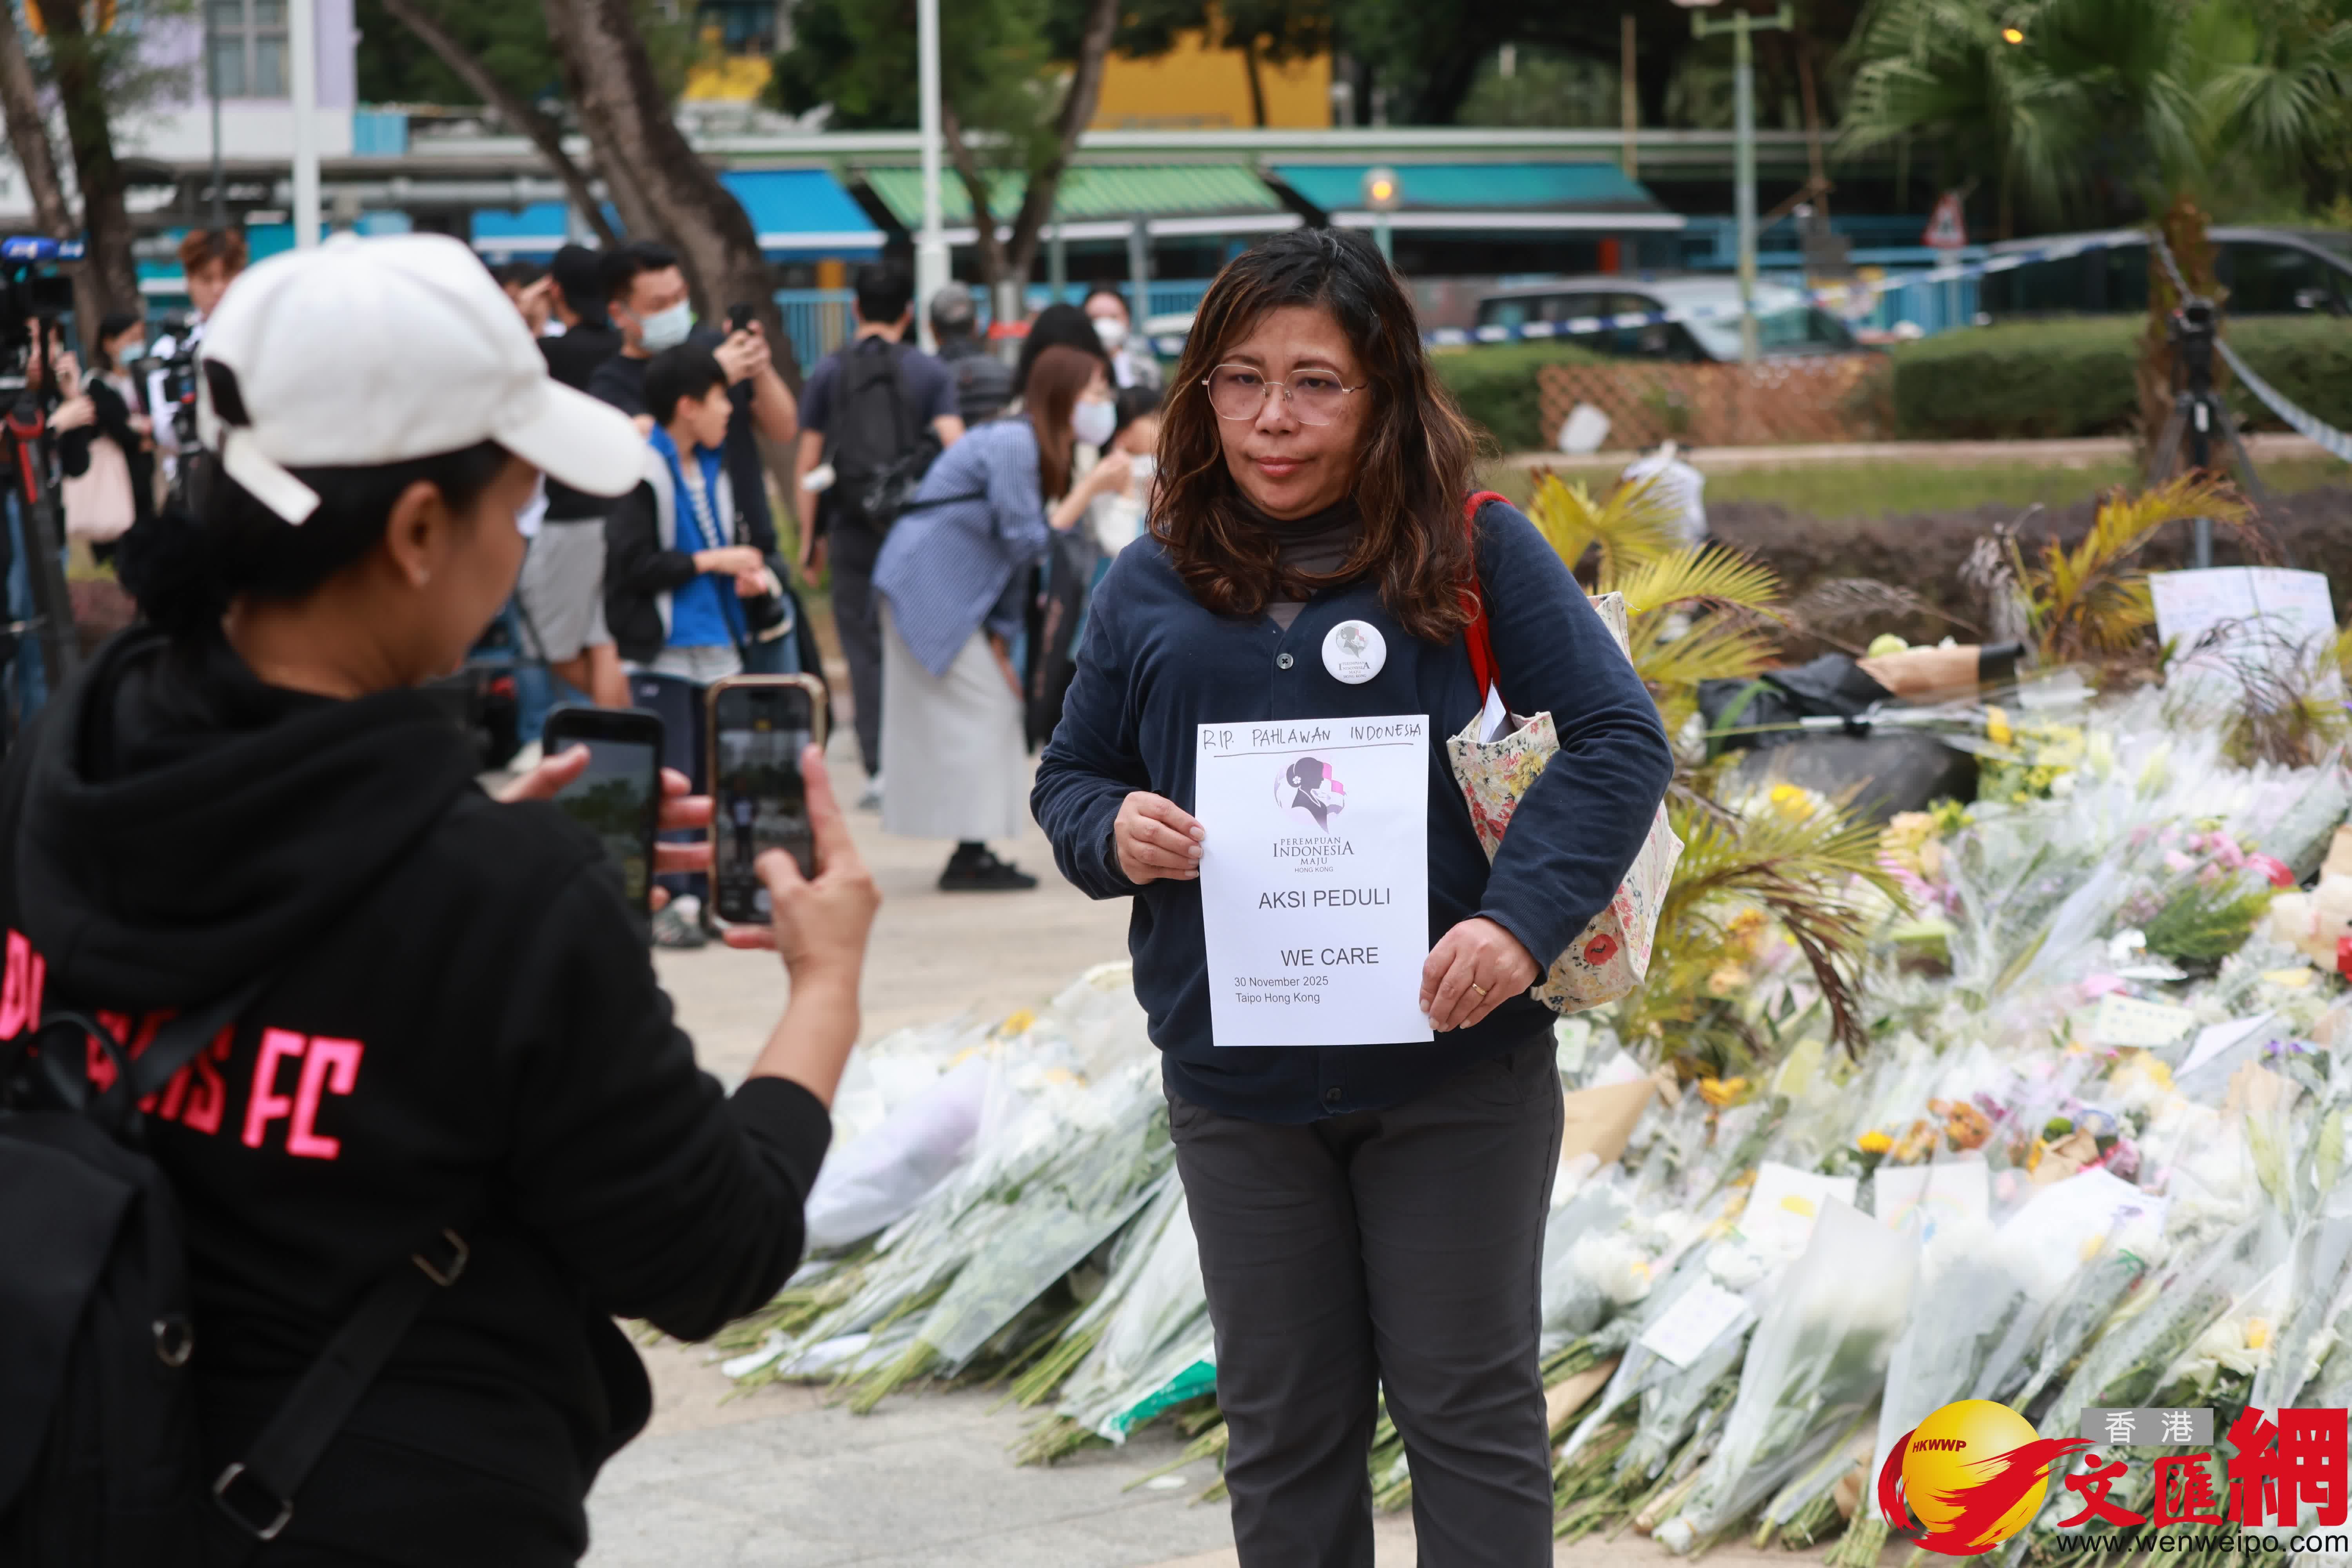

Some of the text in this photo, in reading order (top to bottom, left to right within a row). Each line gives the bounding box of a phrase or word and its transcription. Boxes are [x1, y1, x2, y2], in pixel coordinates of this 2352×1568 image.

[1339, 662, 1370, 670] INDONESIA
[1252, 727, 1331, 747] PAHLAWAN
[1273, 840, 1354, 857] INDONESIA
[1280, 837, 1341, 845] PEREMPUAN
[1301, 857, 1328, 866] MAJU
[1259, 888, 1390, 909] AKSI PEDULI
[1281, 947, 1379, 967] WE CARE
[1234, 976, 1328, 987] 30 November 2025
[1235, 992, 1320, 1005] Taipo Hong Kong
[241, 1027, 365, 1160] FC
